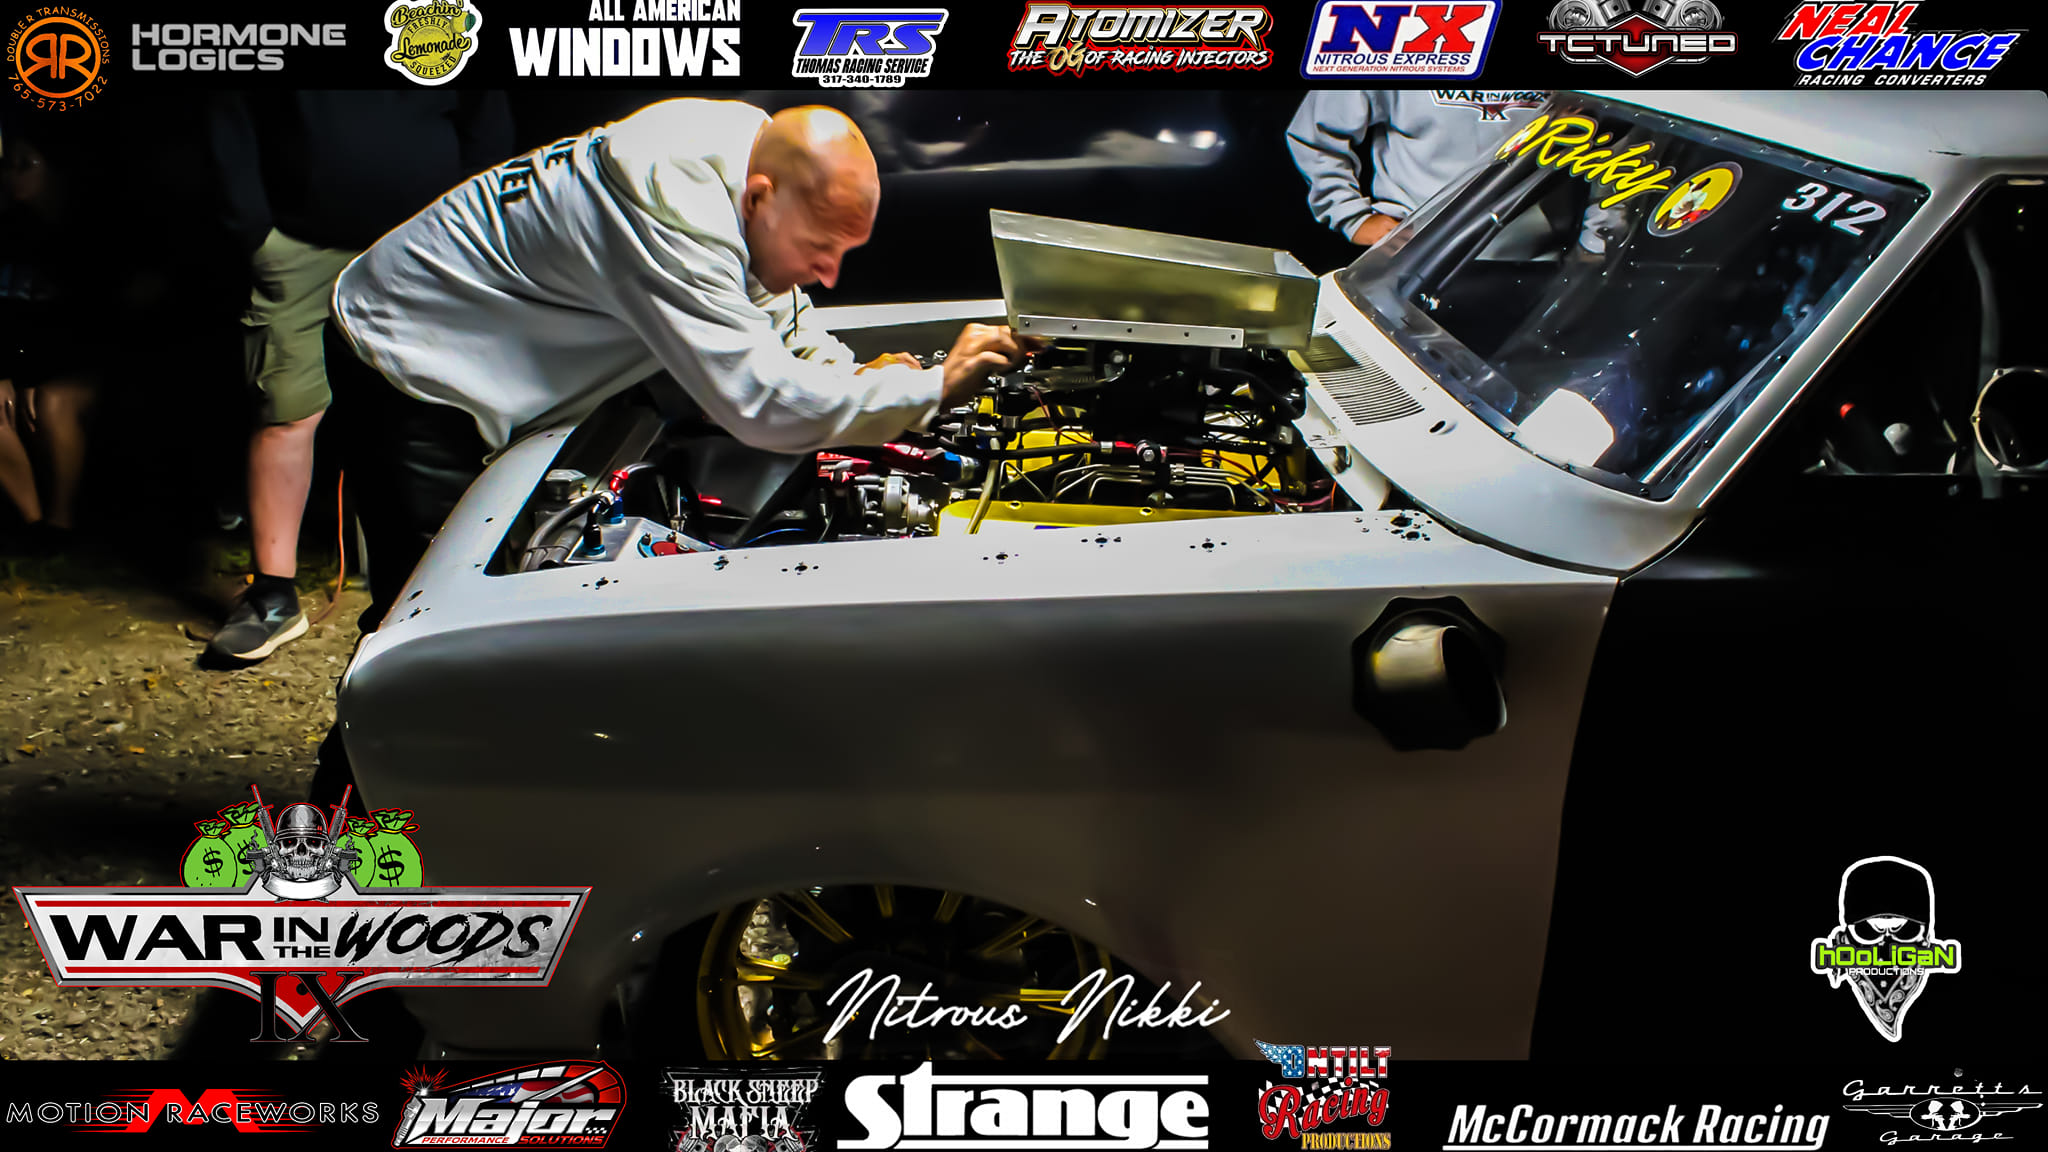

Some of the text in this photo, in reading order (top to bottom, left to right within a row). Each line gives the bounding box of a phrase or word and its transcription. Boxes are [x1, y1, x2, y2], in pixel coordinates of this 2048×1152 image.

[1436, 90, 1484, 102] WAR
[1517, 115, 1676, 209] Ricky
[1781, 182, 1888, 236] 312
